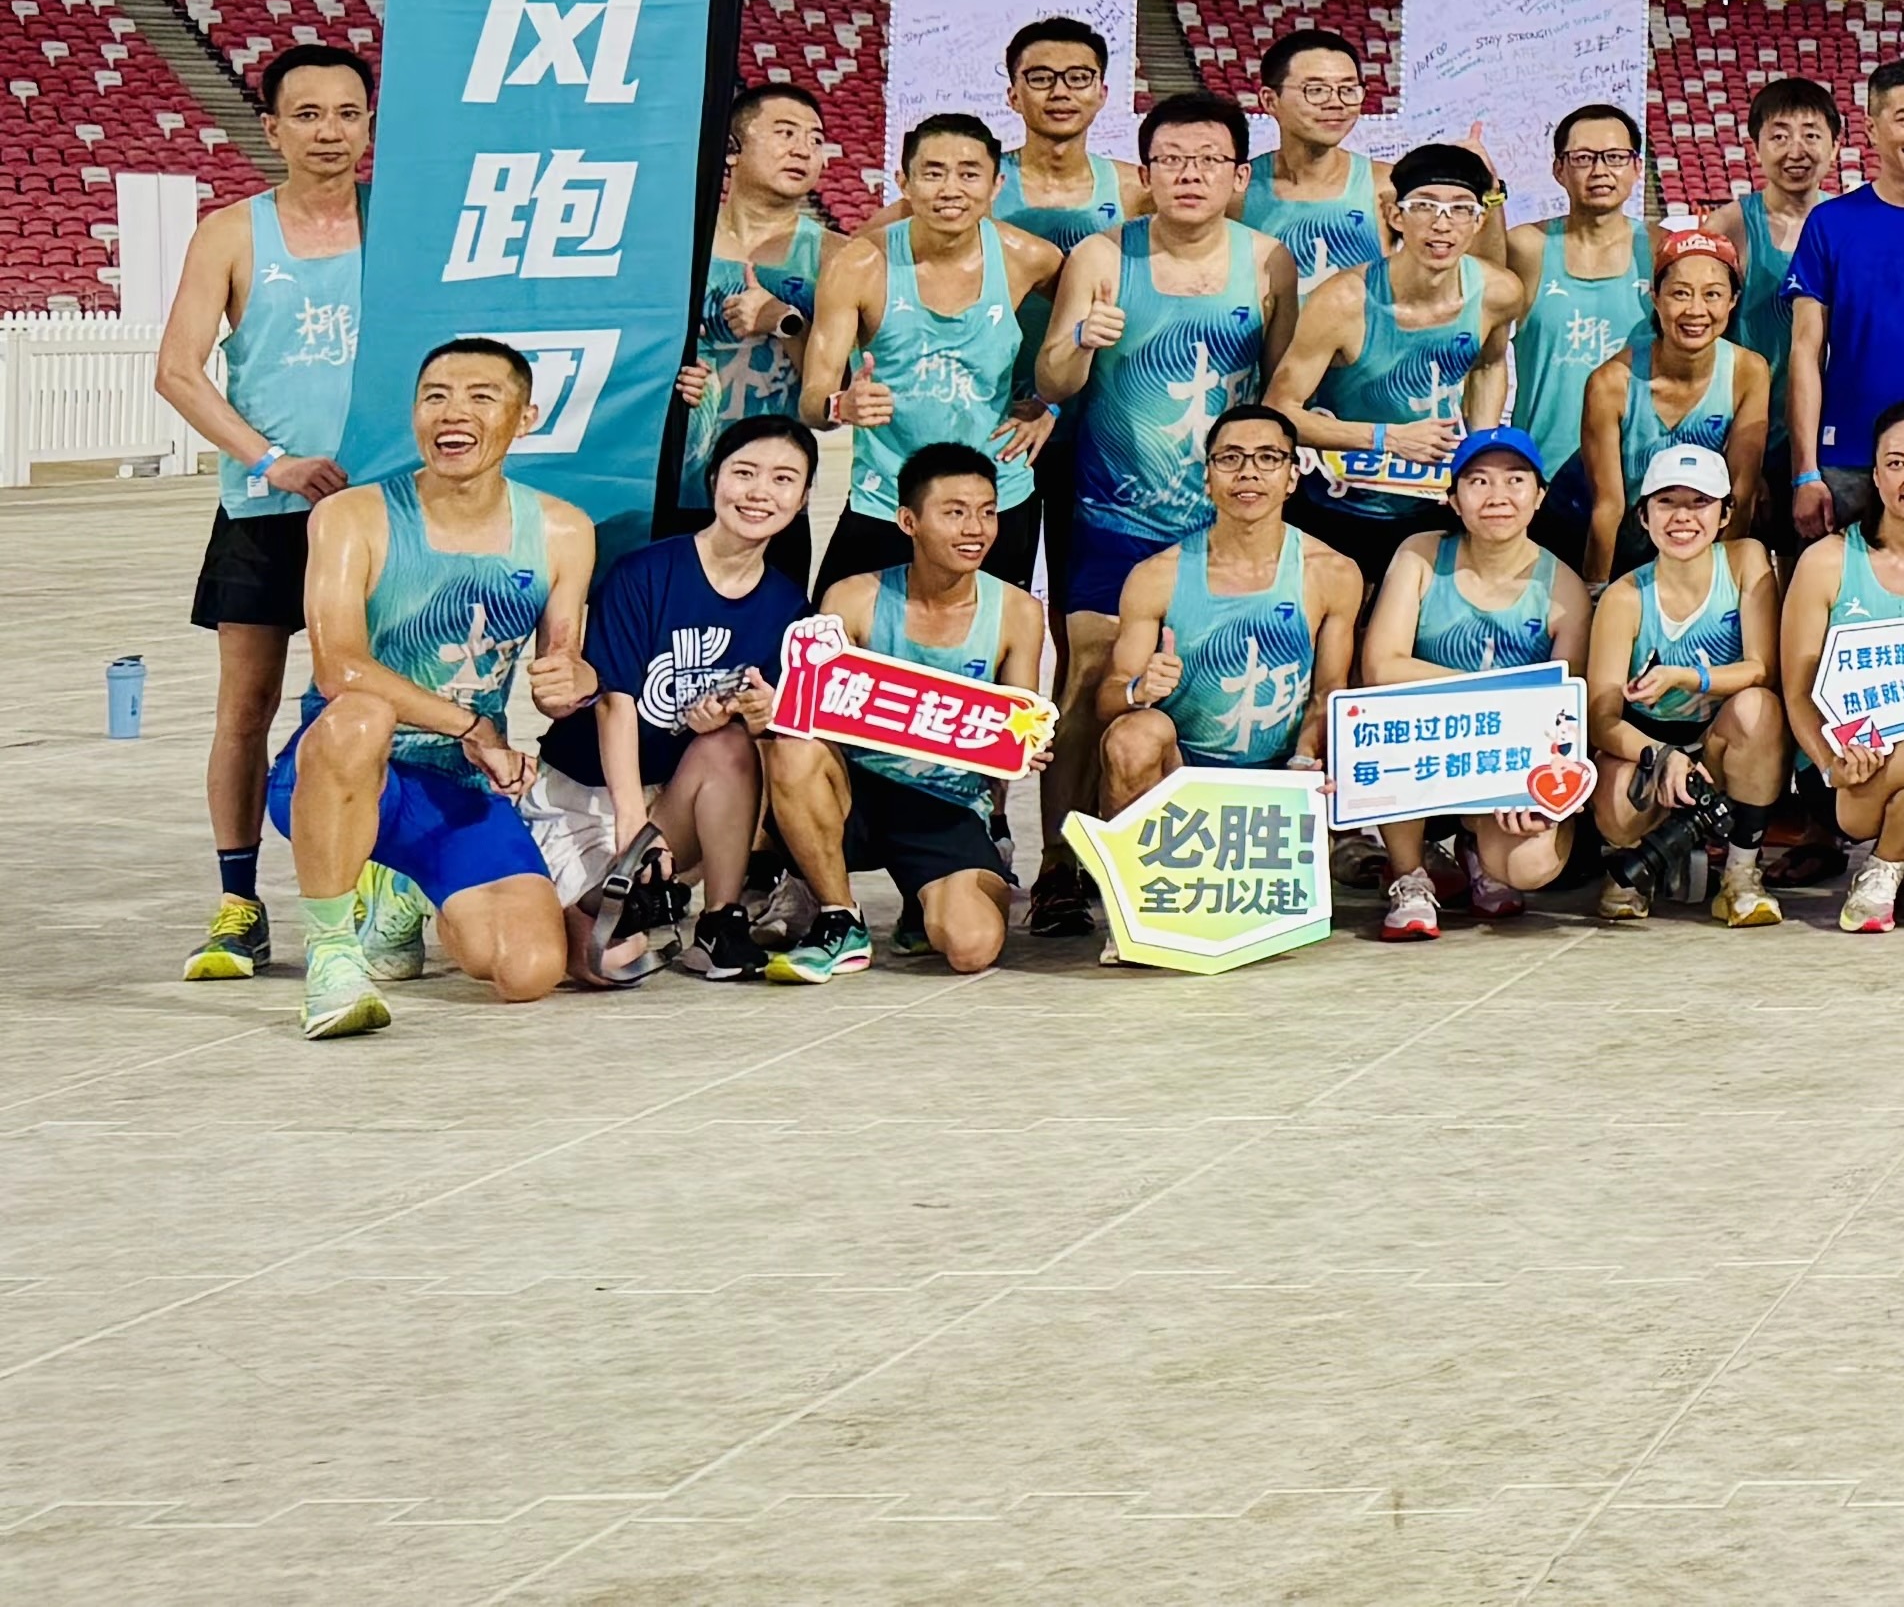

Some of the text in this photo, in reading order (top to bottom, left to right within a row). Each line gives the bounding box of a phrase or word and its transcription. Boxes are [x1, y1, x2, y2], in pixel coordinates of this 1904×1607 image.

[818, 664, 1007, 751] 破三起步
[1352, 705, 1503, 745] 你跑过的路
[1351, 743, 1534, 787] 每一步都算数
[1138, 876, 1309, 916] 全力以赴
